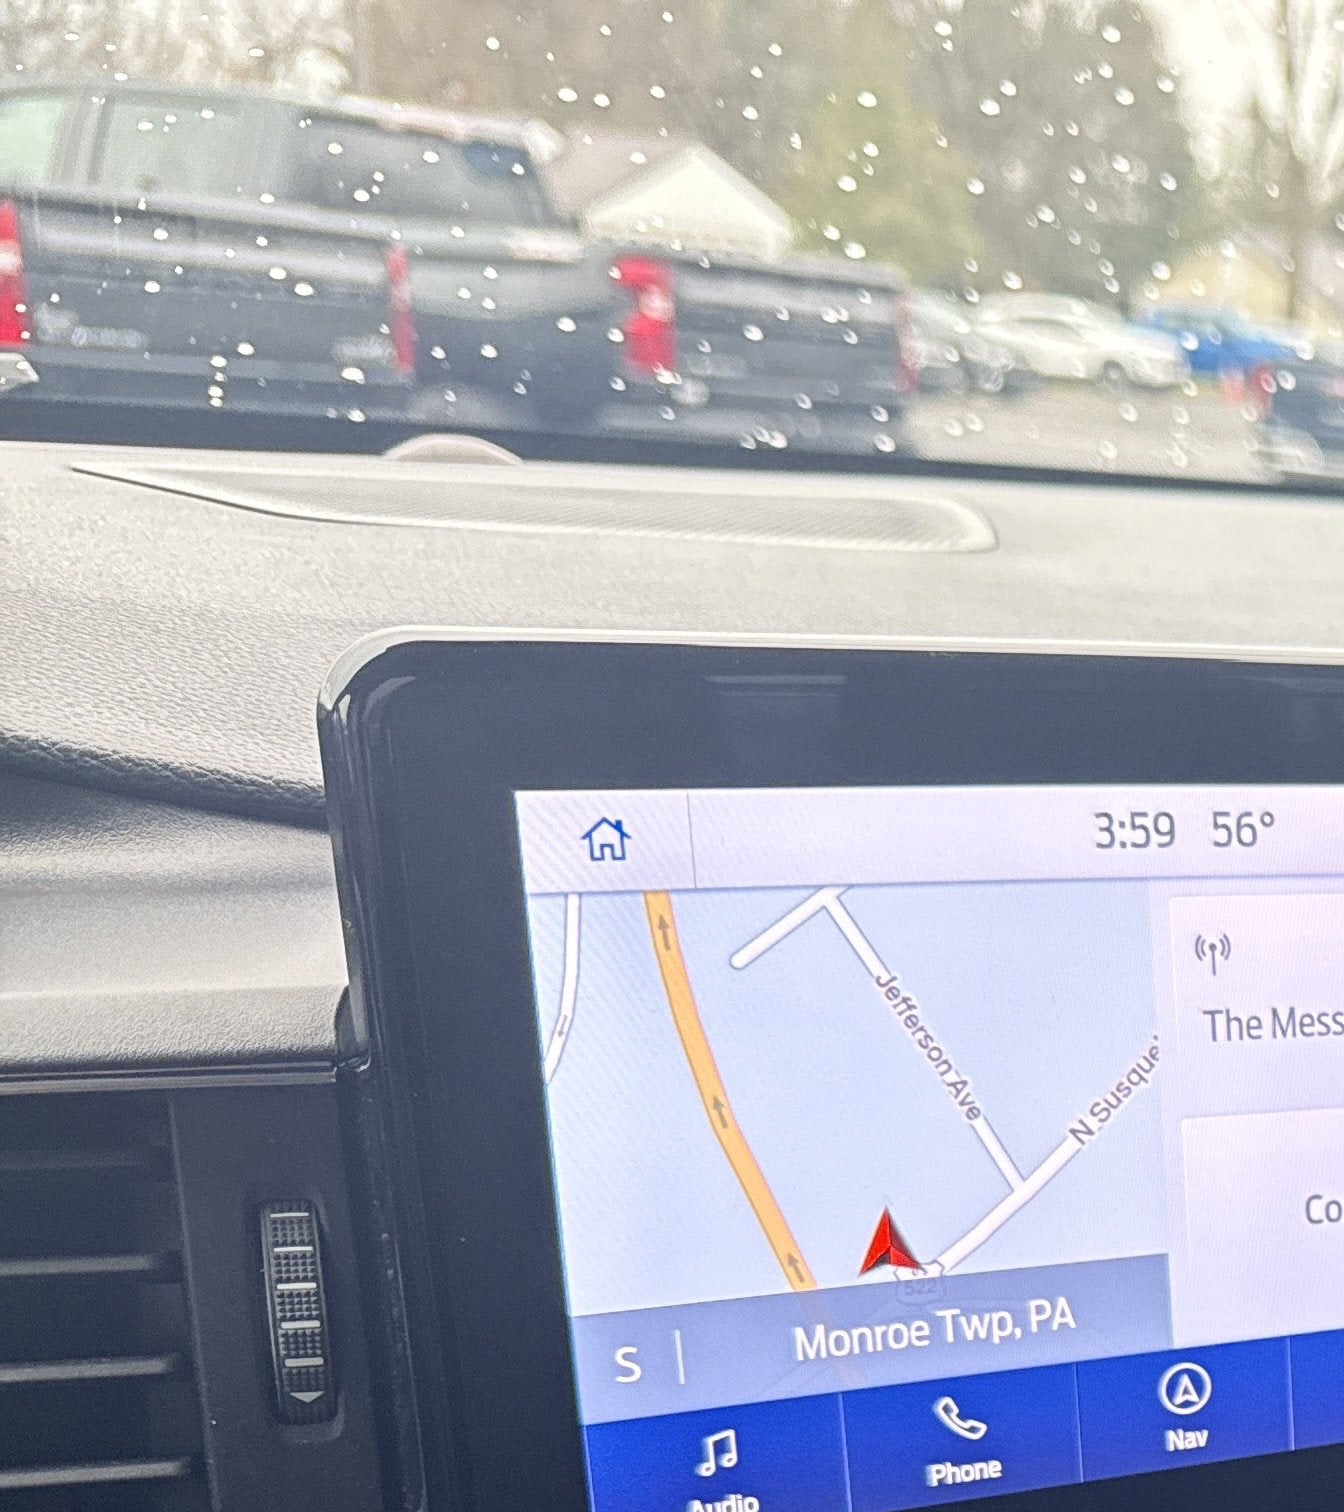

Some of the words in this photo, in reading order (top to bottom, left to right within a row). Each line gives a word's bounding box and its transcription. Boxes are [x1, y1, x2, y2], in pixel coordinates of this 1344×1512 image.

[1094, 811, 1176, 849] 3:59
[1211, 811, 1275, 847] 56°
[1203, 1008, 1263, 1043] The
[875, 975, 953, 1077] Jefferson
[946, 1078, 981, 1121] Ave
[1069, 1119, 1096, 1146] N
[1090, 1035, 1160, 1123] Susque
[614, 1346, 642, 1384] S
[795, 1314, 930, 1361] Monroe
[936, 1307, 1021, 1344] Twp,
[1029, 1296, 1077, 1332] PA
[1165, 1428, 1209, 1452] Nav
[925, 1457, 1002, 1487] Phone
